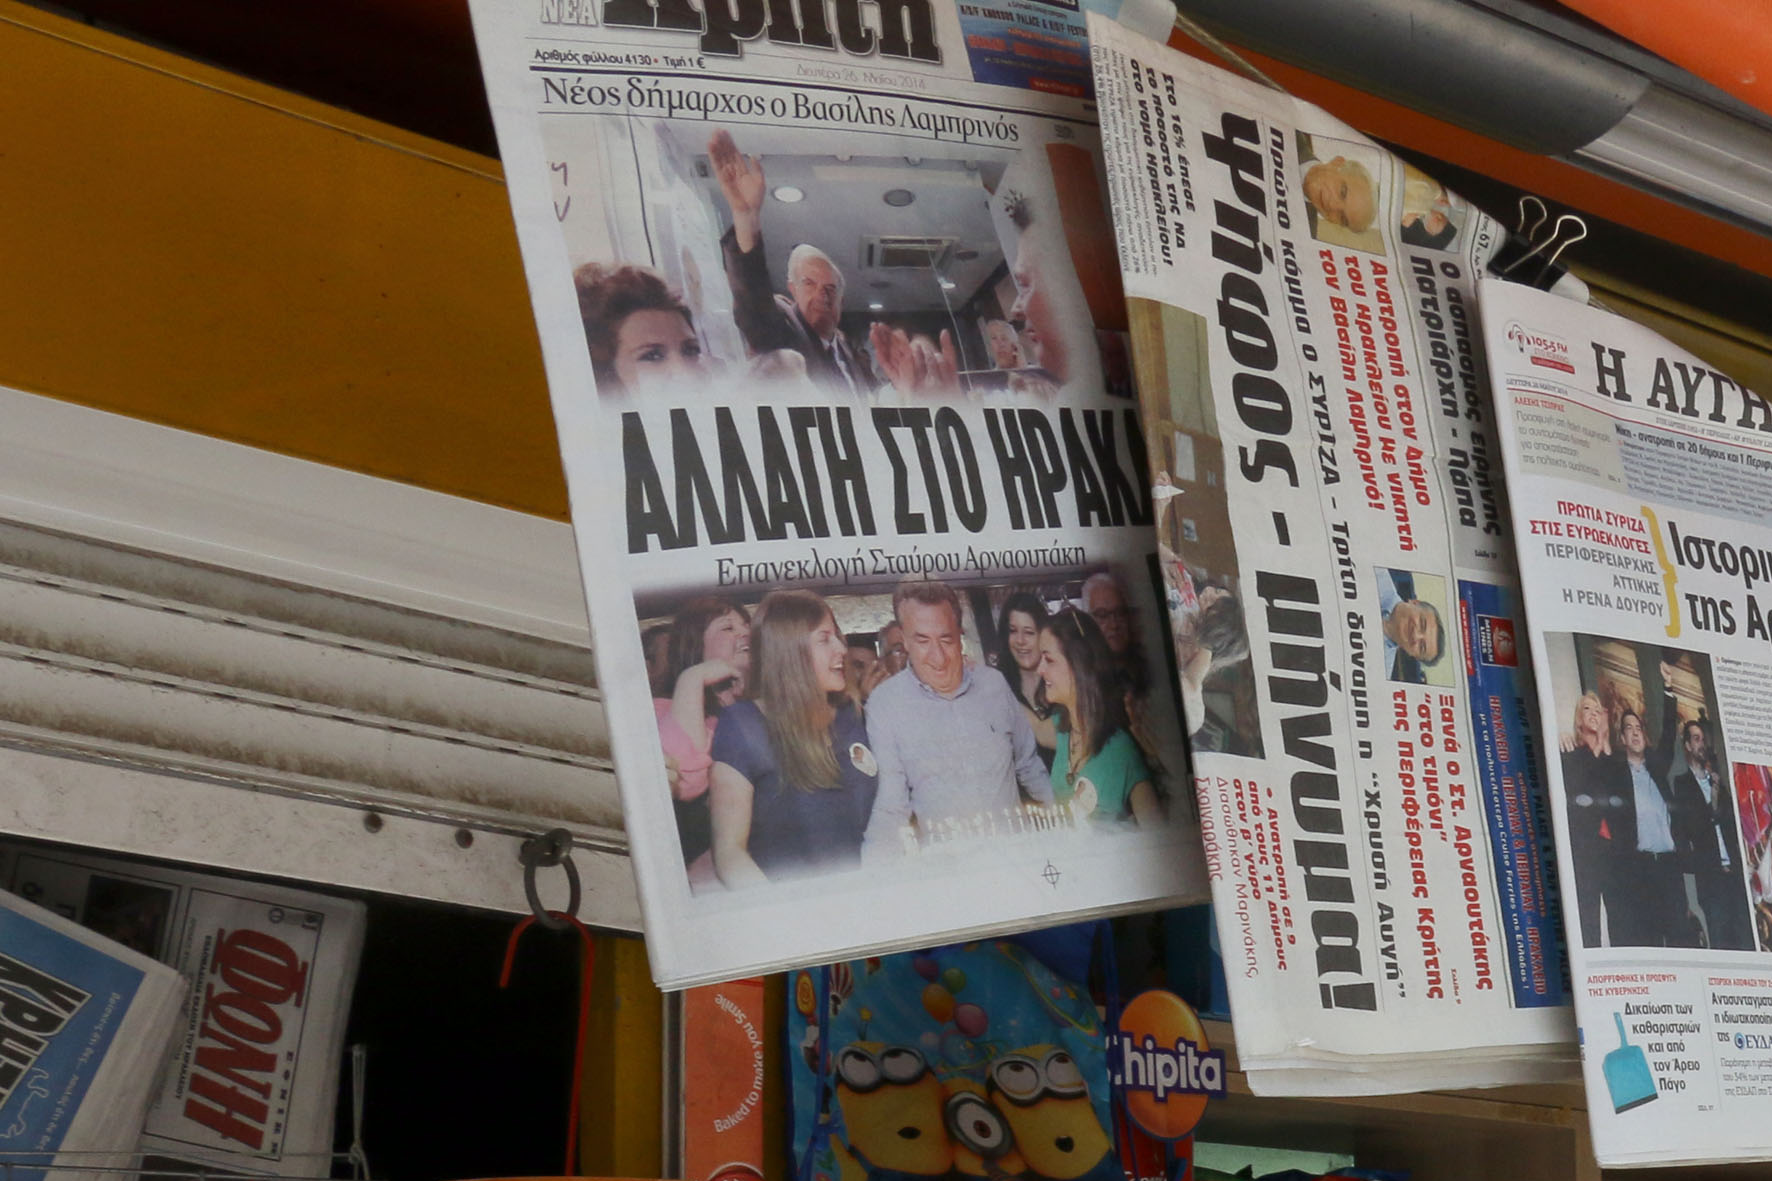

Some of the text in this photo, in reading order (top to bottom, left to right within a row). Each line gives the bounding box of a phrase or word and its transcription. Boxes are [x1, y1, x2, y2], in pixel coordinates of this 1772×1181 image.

[534, 49, 685, 69] Αριθμός φύλλου 4130 Τιμή
[543, 77, 1020, 142] Νέος δήμαρχος ο Βασίλης Λαμπρινός
[1153, 91, 1181, 216] ποσοστό της
[1130, 59, 1174, 267] στο νομό Ηρακλείου!
[1178, 154, 1195, 212] έπεσε
[1319, 249, 1386, 511] τον Βασίλη Λαμπρινό!
[1370, 259, 1431, 506] Ανατροπή στον Δήμο
[1410, 255, 1477, 527] Πατριάρχη Πάπα
[1446, 286, 1481, 423] ασπασμός
[1591, 341, 1632, 403] Η
[1270, 126, 1370, 728] Πρώτο κόμμα ΣΥΡΙΖΑ Τρίτη δύναμη
[1344, 256, 1418, 552] του Ηρακλείου νικητή
[621, 406, 876, 555] ΑΛΛΑΓΗ
[875, 405, 986, 536] ΣΤΟ
[1557, 500, 1645, 534] ΠΡΩΤΙΑ ΣΥΡΙΖΑ
[715, 545, 1088, 588] Επανεκλογή Σταύρου Αρναουτάκη
[1202, 111, 1378, 1012] Ψήφος μήνυμα!
[1530, 519, 1652, 554] ΣΤΙΣ ΕΥΡΩΕΚΛΟΓΕΣ
[1545, 543, 1657, 575] ΠΕΡΙΦΕΡΕΙΑΡΧΗΣ
[1562, 588, 1664, 618] Η ΡΕΝΑ ΔΟΥΡΟΥ
[1613, 574, 1661, 596] ΑΤΤΙΚΗΣ
[1685, 592, 1737, 636] της
[1216, 777, 1243, 877] Διασώθηκαν
[1233, 779, 1261, 900] στον γύρο
[1267, 807, 1290, 900] Ανατροπή
[1393, 689, 1444, 1000] της Περιφέρειας Κρήτης
[1439, 694, 1493, 990] Ξανά Αρναουτάκης
[1248, 780, 1287, 971] από τους Δήμους
[182, 927, 311, 1152] ΦΩΝΗ
[1624, 1001, 1694, 1018] Δικαίωση των
[1632, 1021, 1701, 1037] καθαριστριών
[1648, 1040, 1686, 1055] και από
[1653, 1059, 1671, 1073] τον
[1659, 1078, 1687, 1094] Πάγο
